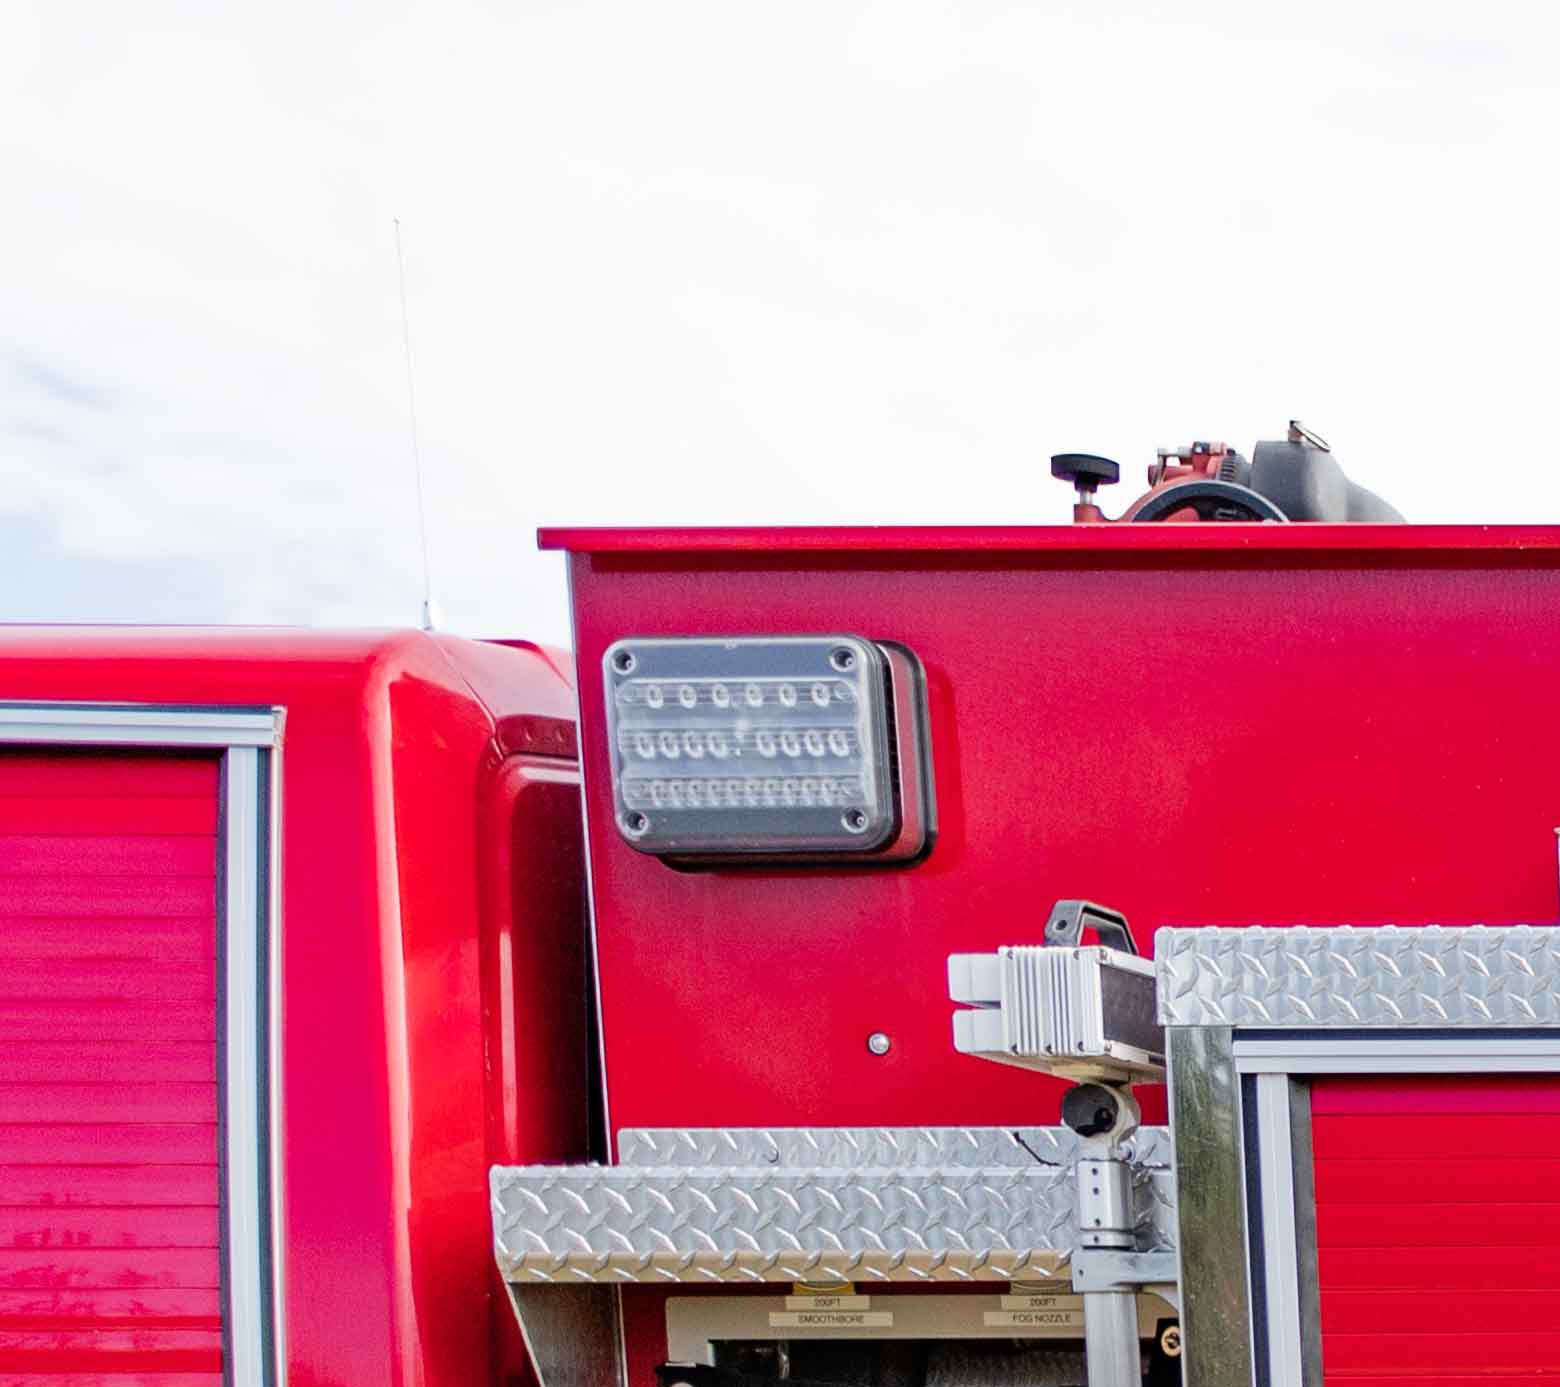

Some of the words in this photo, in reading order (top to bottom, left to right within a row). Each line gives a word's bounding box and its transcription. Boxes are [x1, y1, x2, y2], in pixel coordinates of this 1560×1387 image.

[798, 1315, 865, 1324] SMOOTHBORE
[1013, 1314, 1033, 1323] FOG
[1034, 1314, 1072, 1323] NOZZLE
